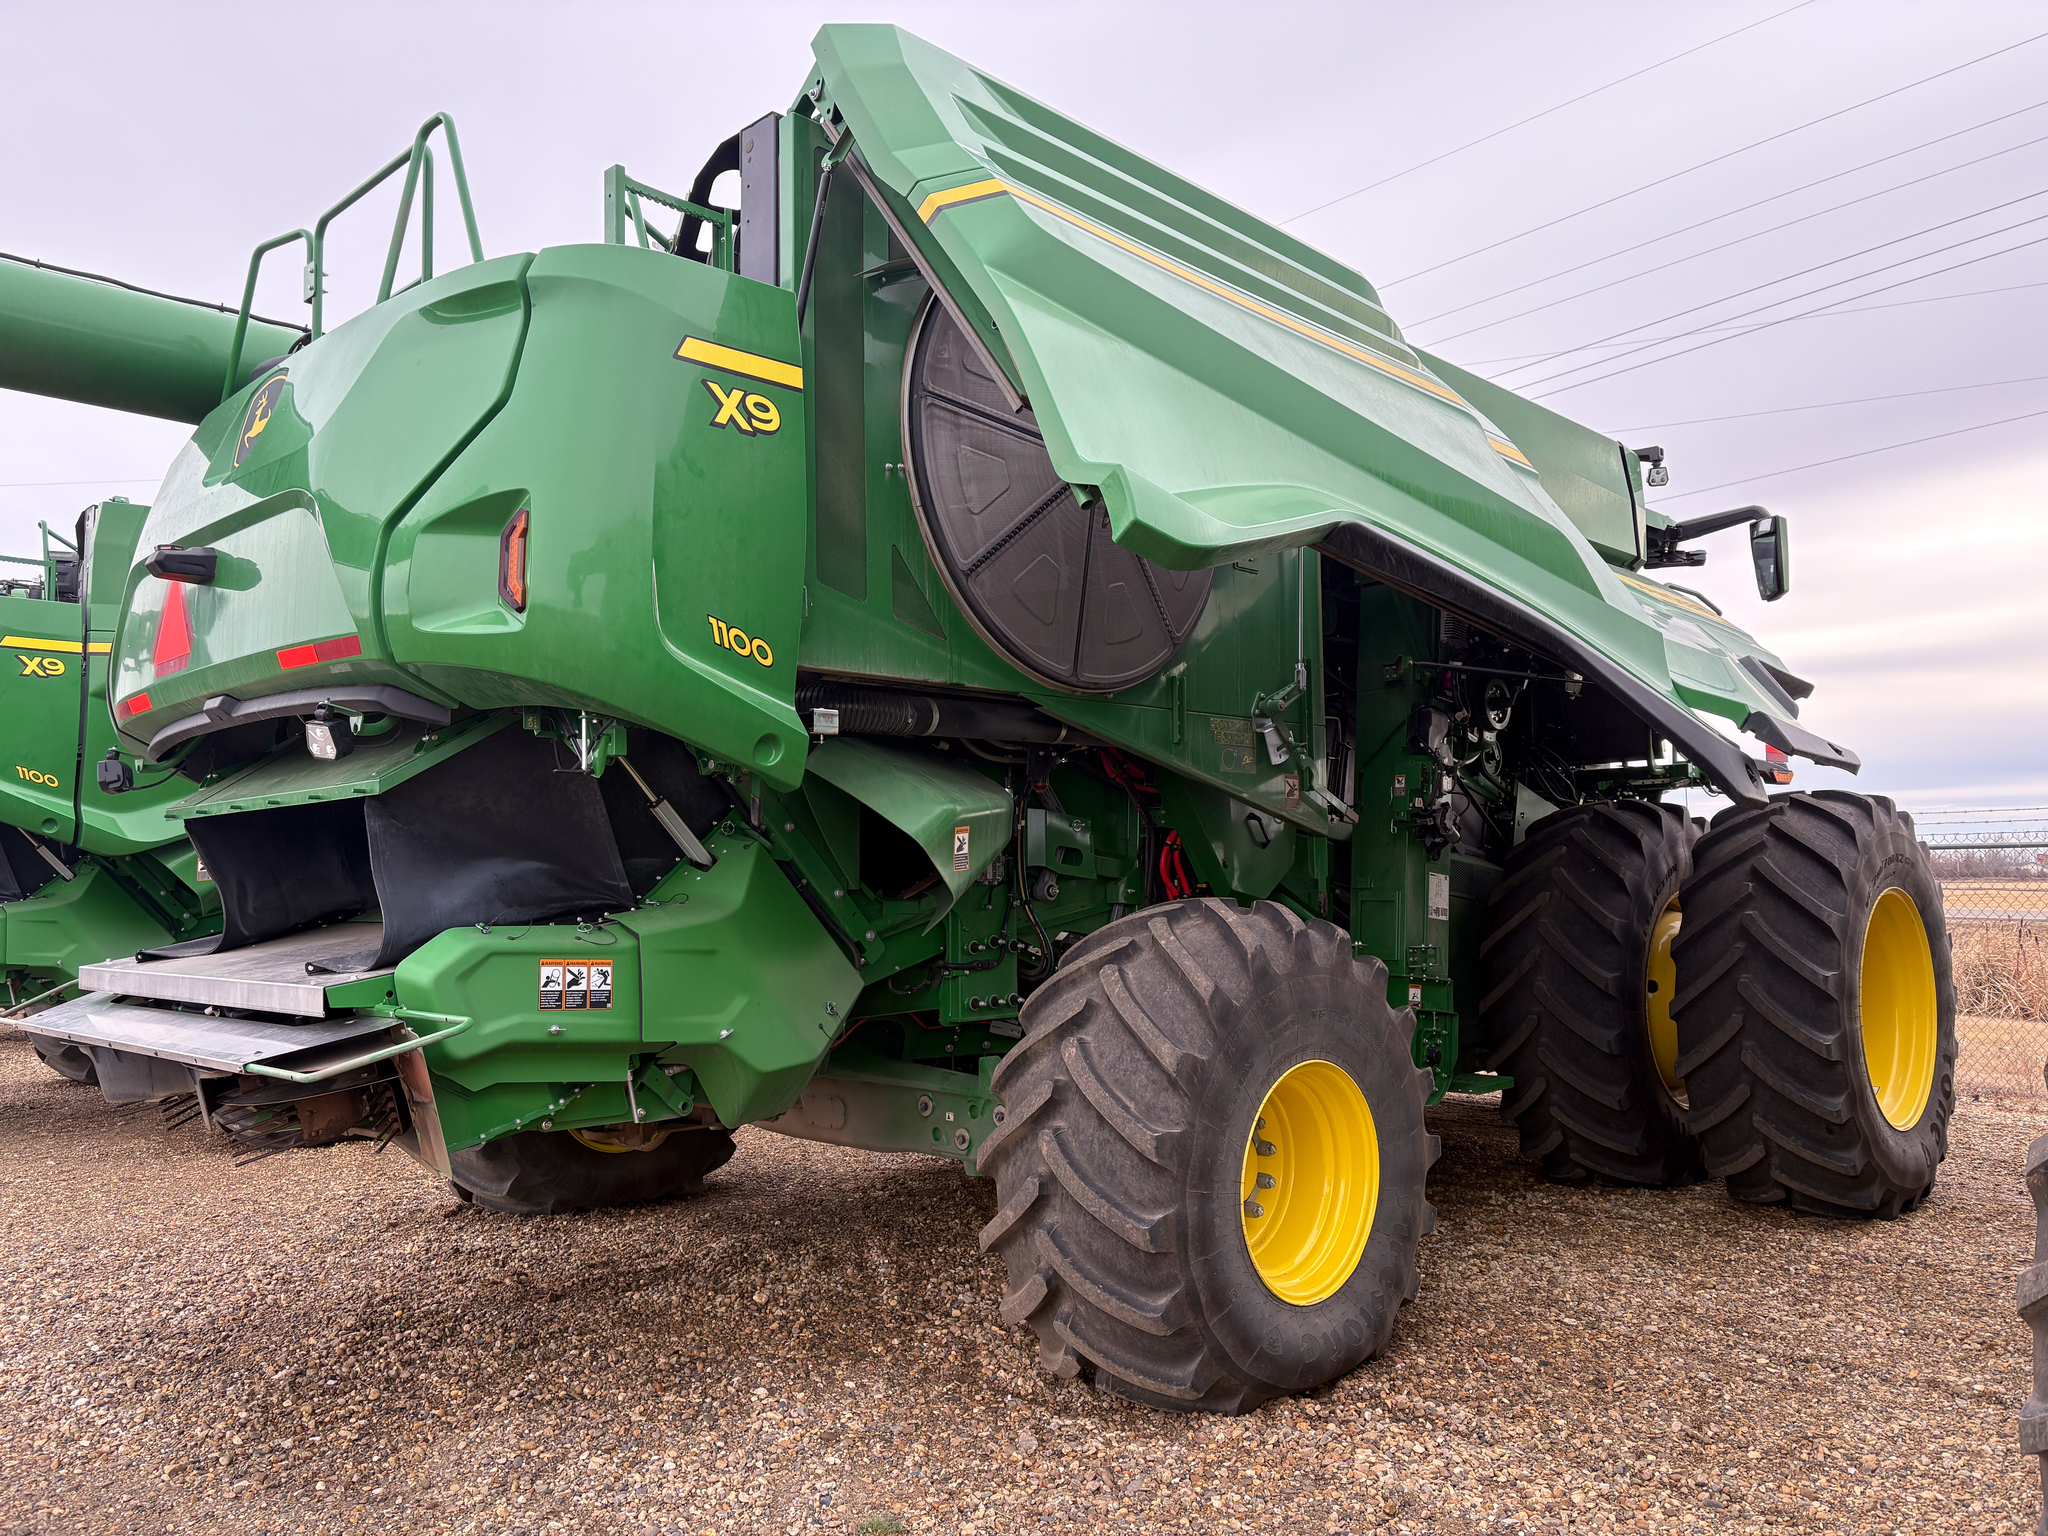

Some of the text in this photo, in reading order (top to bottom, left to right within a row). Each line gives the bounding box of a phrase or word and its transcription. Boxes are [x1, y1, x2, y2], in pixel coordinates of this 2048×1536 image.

[701, 378, 781, 437] X9
[707, 614, 774, 668] 1100
[15, 654, 66, 678] X9
[15, 765, 60, 788] 1100
